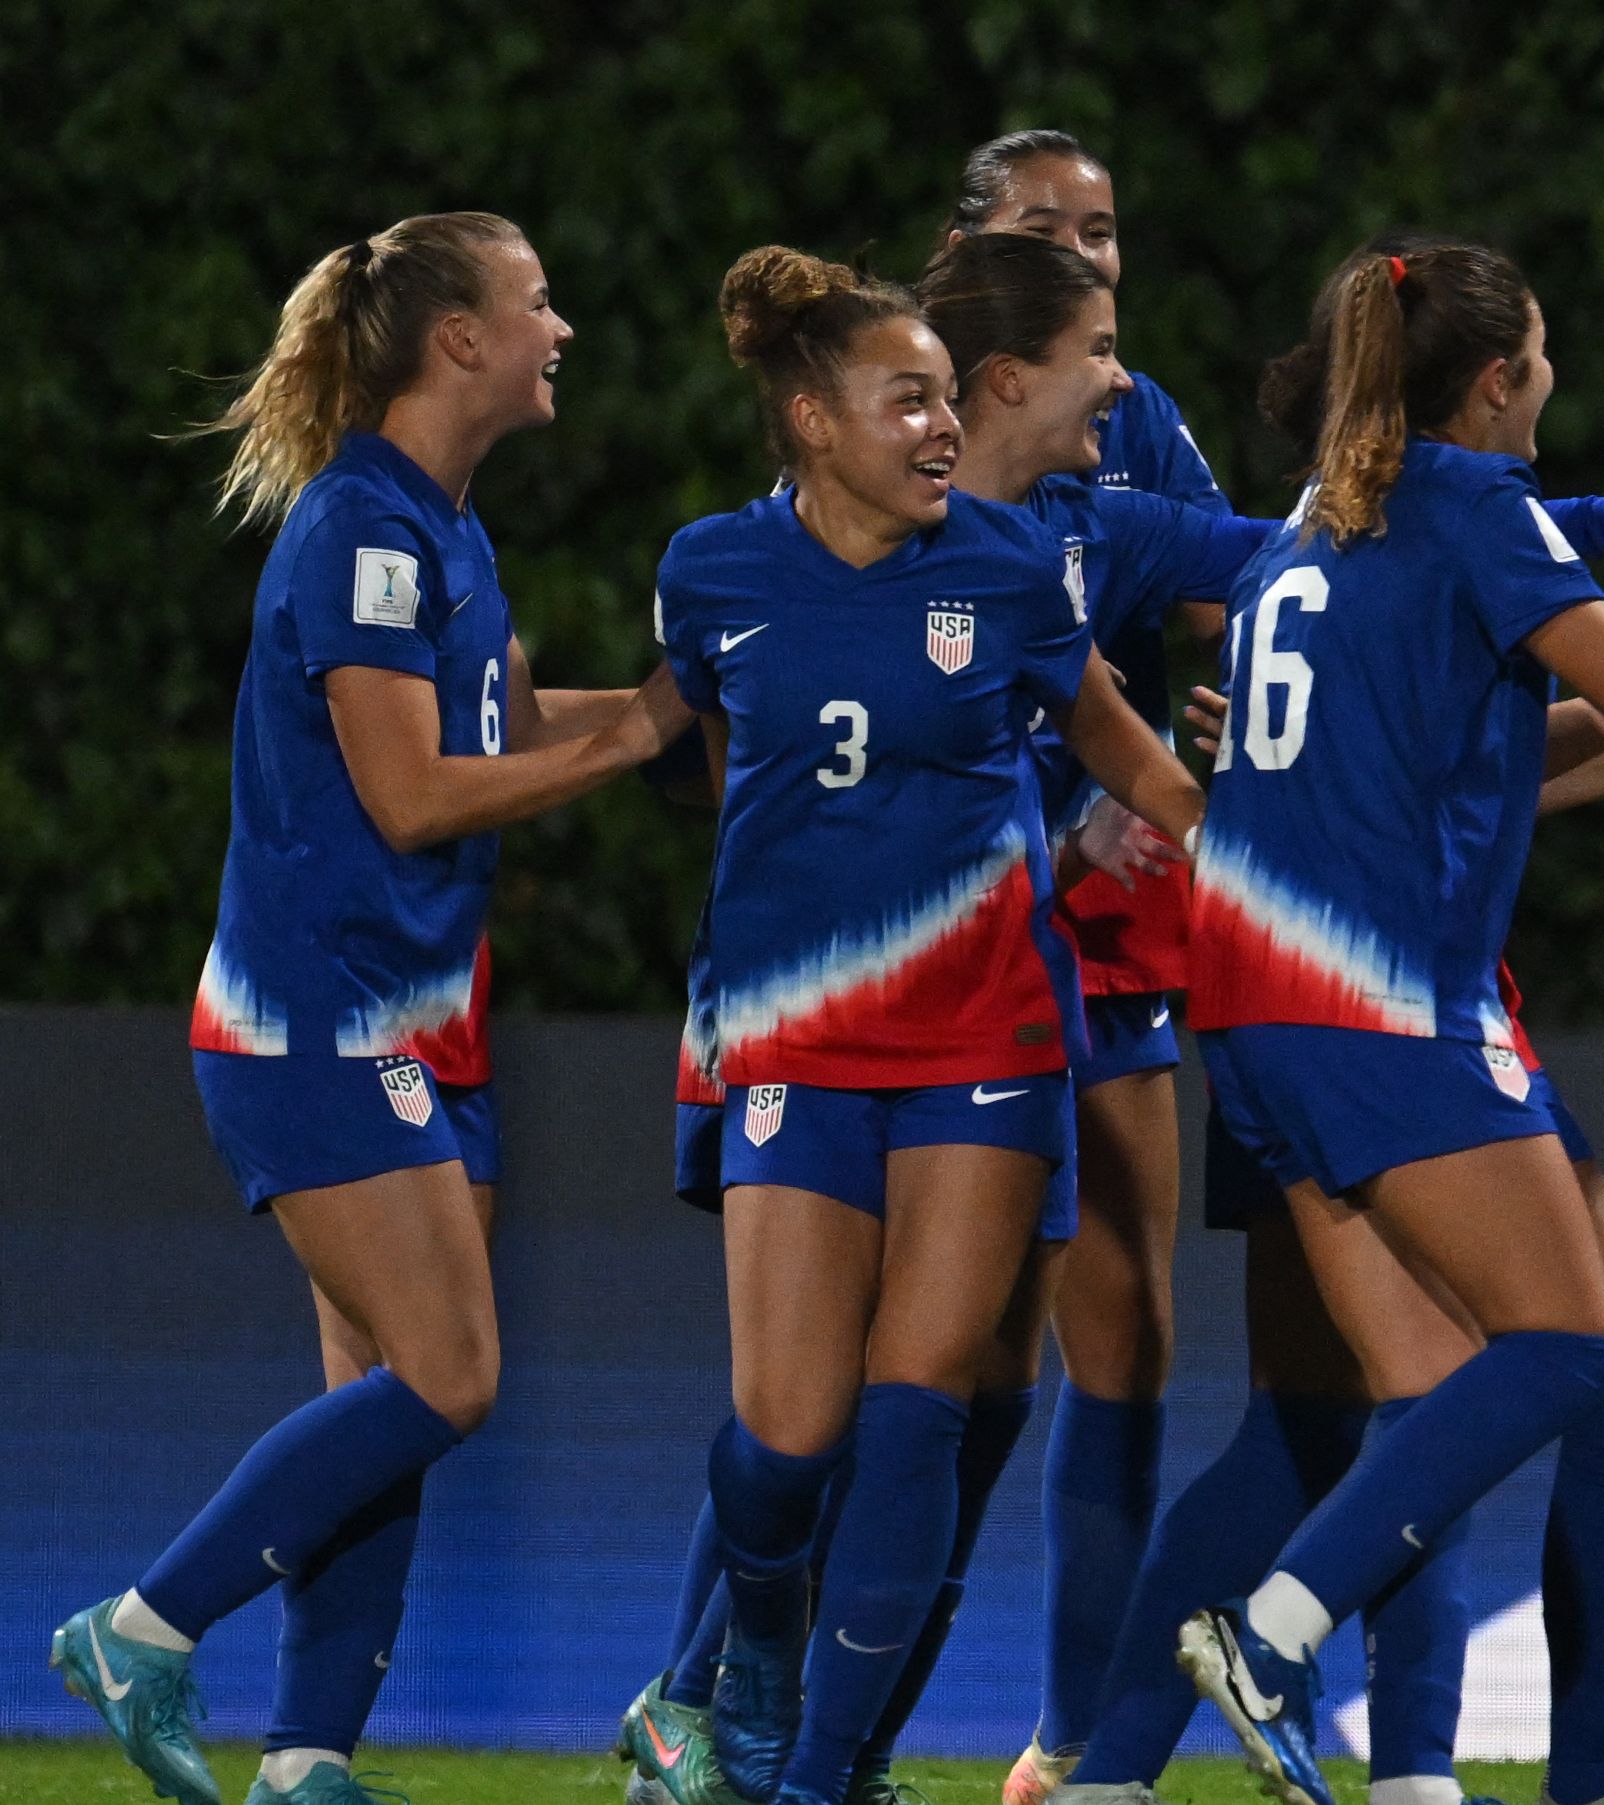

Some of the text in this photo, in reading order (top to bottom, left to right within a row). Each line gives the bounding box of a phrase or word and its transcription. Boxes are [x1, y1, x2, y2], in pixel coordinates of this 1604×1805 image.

[930, 614, 971, 639] USA
[480, 658, 501, 757] 6
[816, 700, 869, 789] 3
[383, 1066, 421, 1093] USA
[750, 1087, 784, 1111] USA
